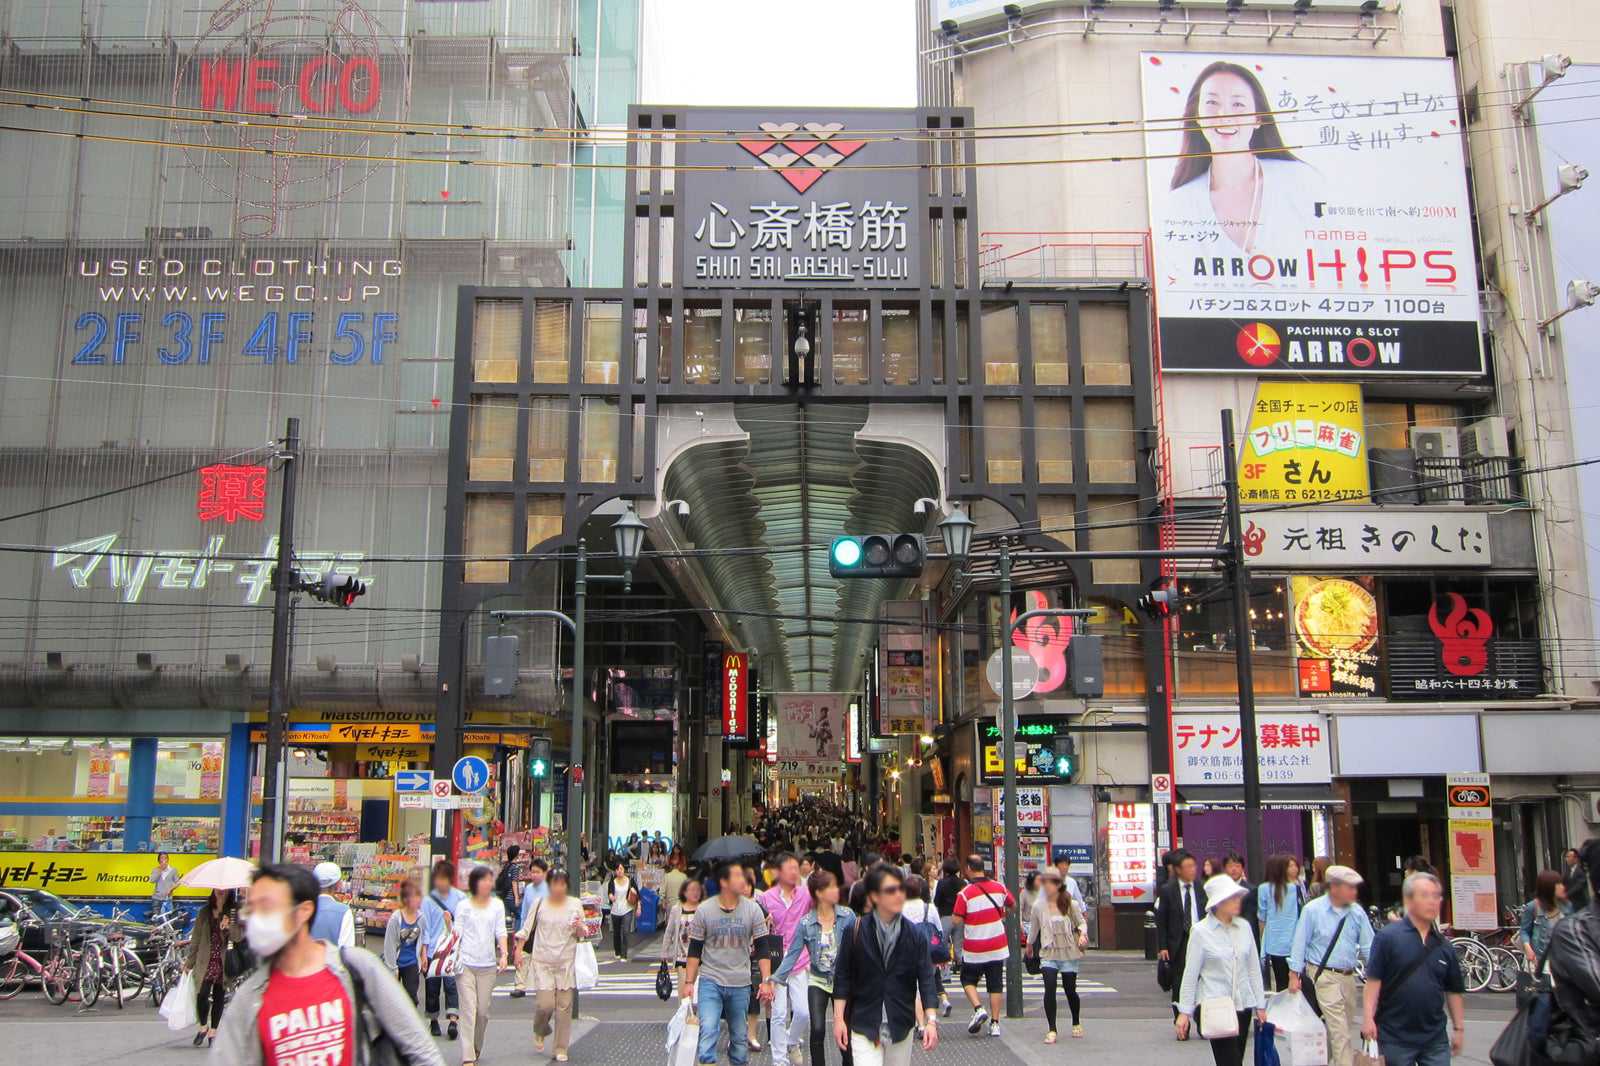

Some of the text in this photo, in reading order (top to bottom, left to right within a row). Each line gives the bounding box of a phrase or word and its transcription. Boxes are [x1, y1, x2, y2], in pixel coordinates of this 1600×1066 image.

[1278, 90, 1444, 119] あそびゴコロが
[1319, 122, 1424, 151] 動き出す。
[694, 201, 908, 250] 心斎橋筋
[1165, 230, 1220, 243] チェ・ジウ
[80, 260, 403, 277] USED CLOTHING
[696, 256, 741, 278] SHIN
[750, 256, 782, 279] SAI
[1193, 254, 1297, 281] ARROW
[100, 285, 381, 302] WWW.WEGO.JP
[1188, 298, 1446, 315] パチンコ&スロット 4フロア 1100台
[72, 312, 400, 366] 2F 3F 4F 5F
[1287, 326, 1400, 337] PACHINKO & SLOT
[1287, 337, 1401, 367] ARROW
[1256, 399, 1359, 414] 全国チェーンの店
[1254, 422, 1358, 451] フリー麻雀
[1244, 459, 1332, 484] 3F さん
[198, 464, 267, 523] 薬
[1415, 679, 1519, 690] 昭和六十四年創業
[1176, 724, 1321, 749] テナン募集中
[1187, 756, 1311, 767] 御堂筋都市発株式会社
[1214, 771, 1294, 780] 06-6-9139
[268, 998, 345, 1041] PAIN
